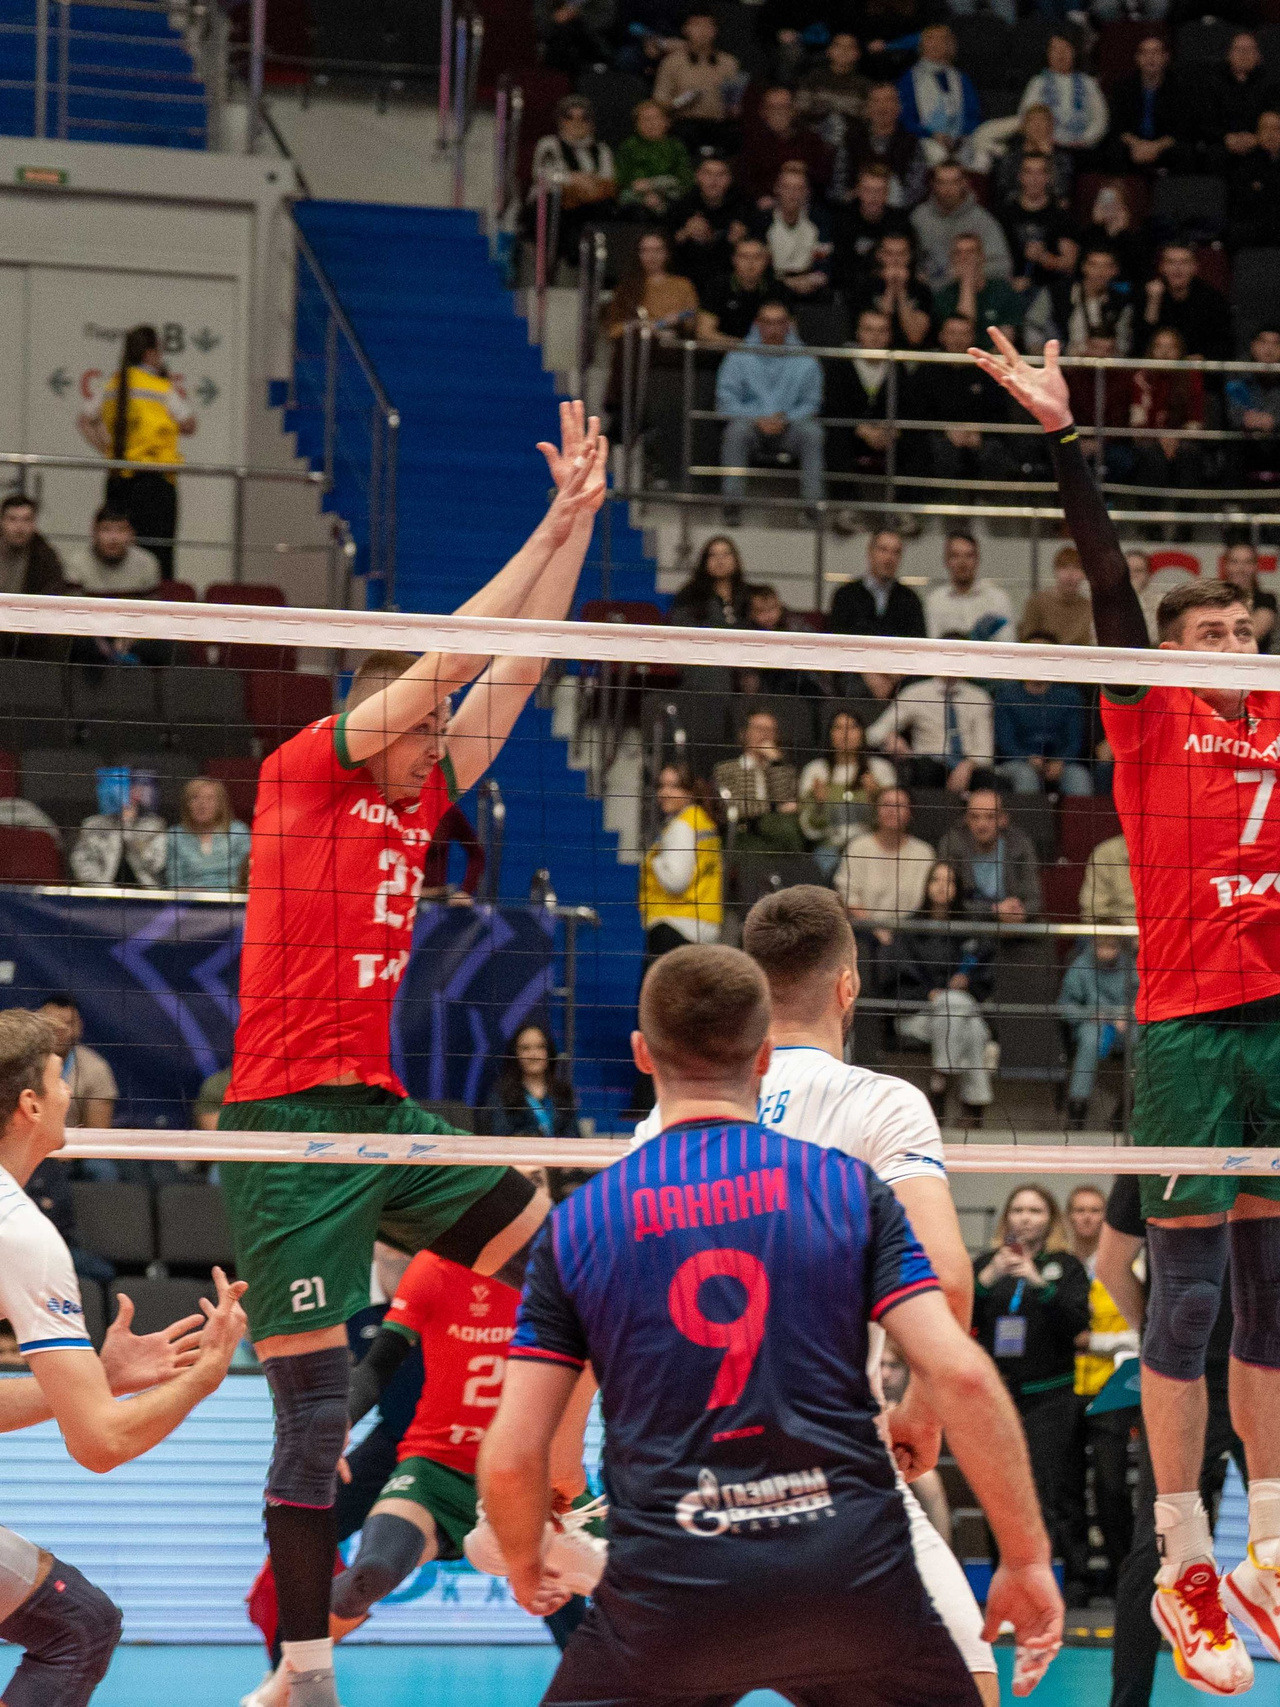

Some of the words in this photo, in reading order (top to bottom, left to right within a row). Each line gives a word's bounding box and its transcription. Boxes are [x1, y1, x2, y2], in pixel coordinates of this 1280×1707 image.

[1233, 768, 1277, 845] 7
[632, 1167, 788, 1242] ДАНАНИ
[290, 1276, 326, 1313] 21
[447, 1323, 517, 1344] ЛОКОМ
[668, 1248, 770, 1411] 9
[462, 1355, 507, 1407] 2
